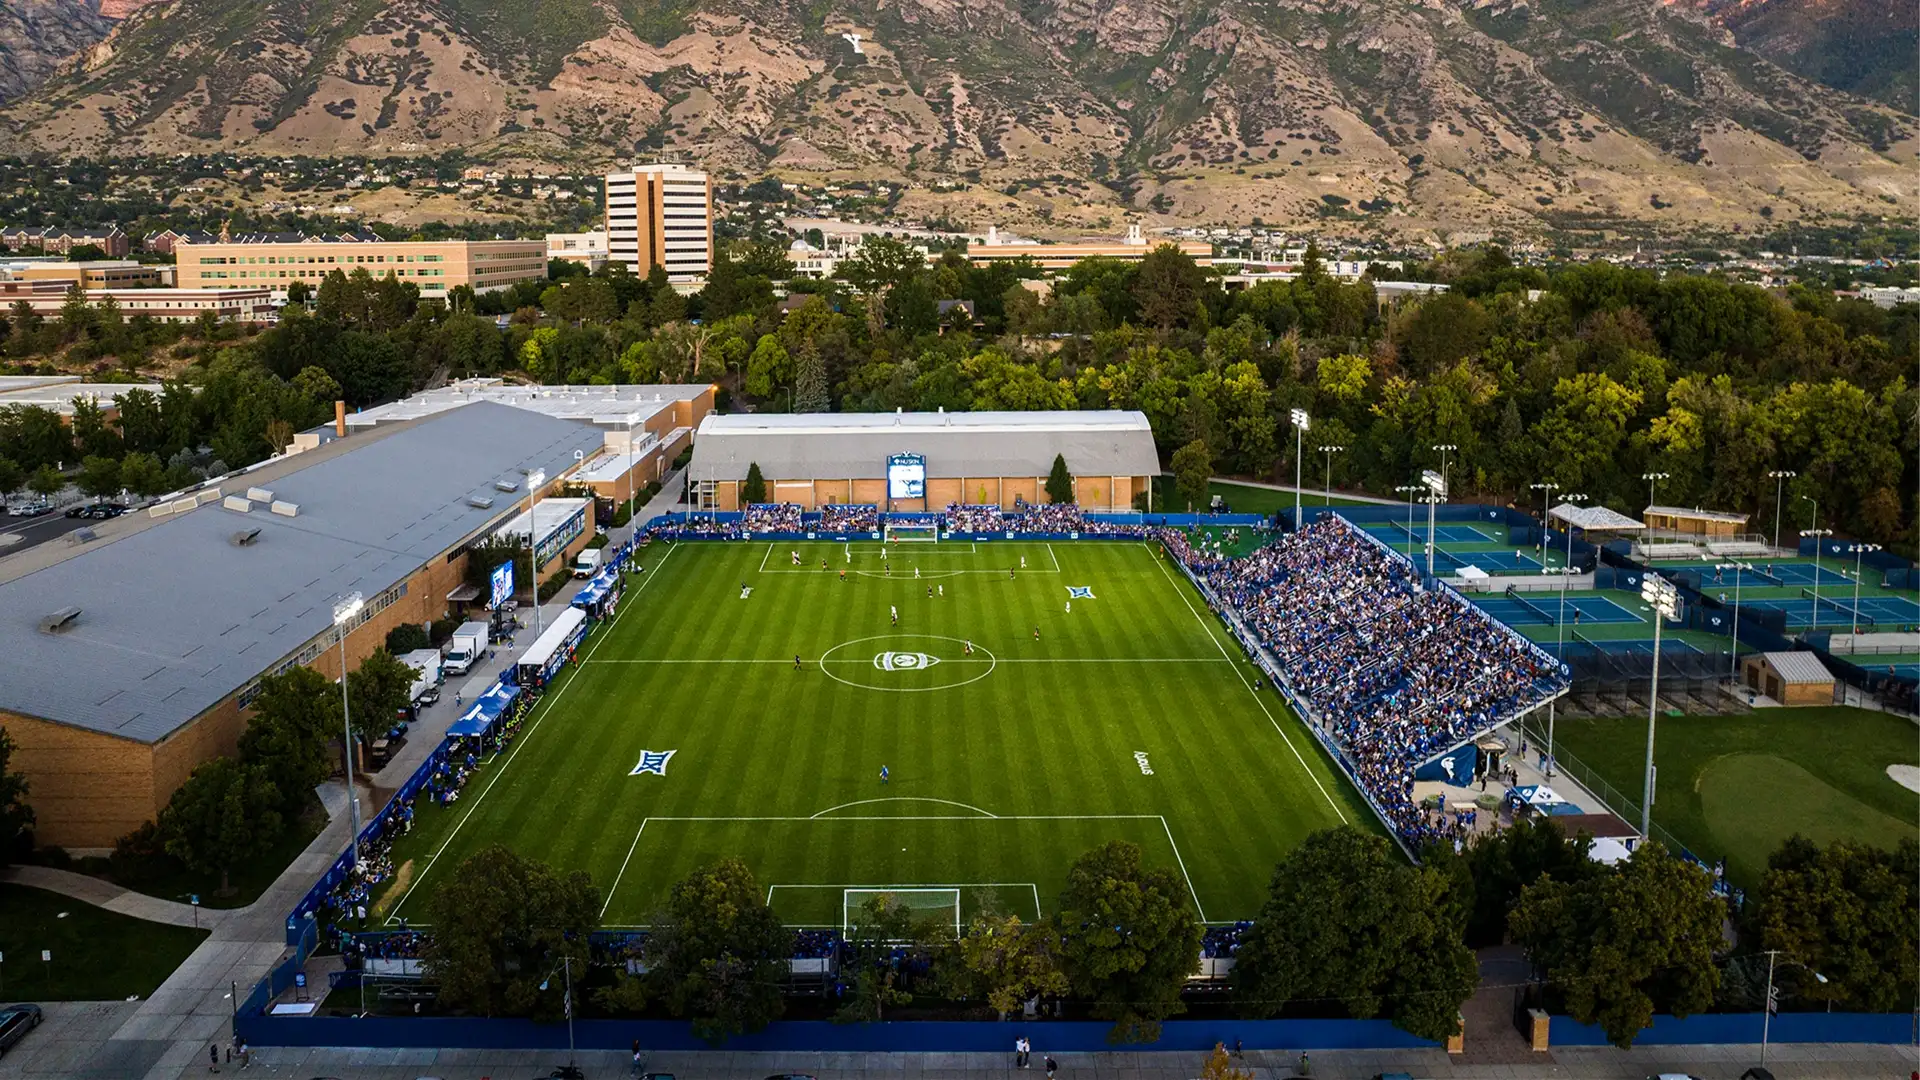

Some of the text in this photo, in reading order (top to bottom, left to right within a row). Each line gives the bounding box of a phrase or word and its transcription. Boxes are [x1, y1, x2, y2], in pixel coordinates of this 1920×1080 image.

[842, 33, 864, 54] Y
[1490, 616, 1530, 647] UNIVERSITY
[1530, 643, 1559, 669] SOCCER
